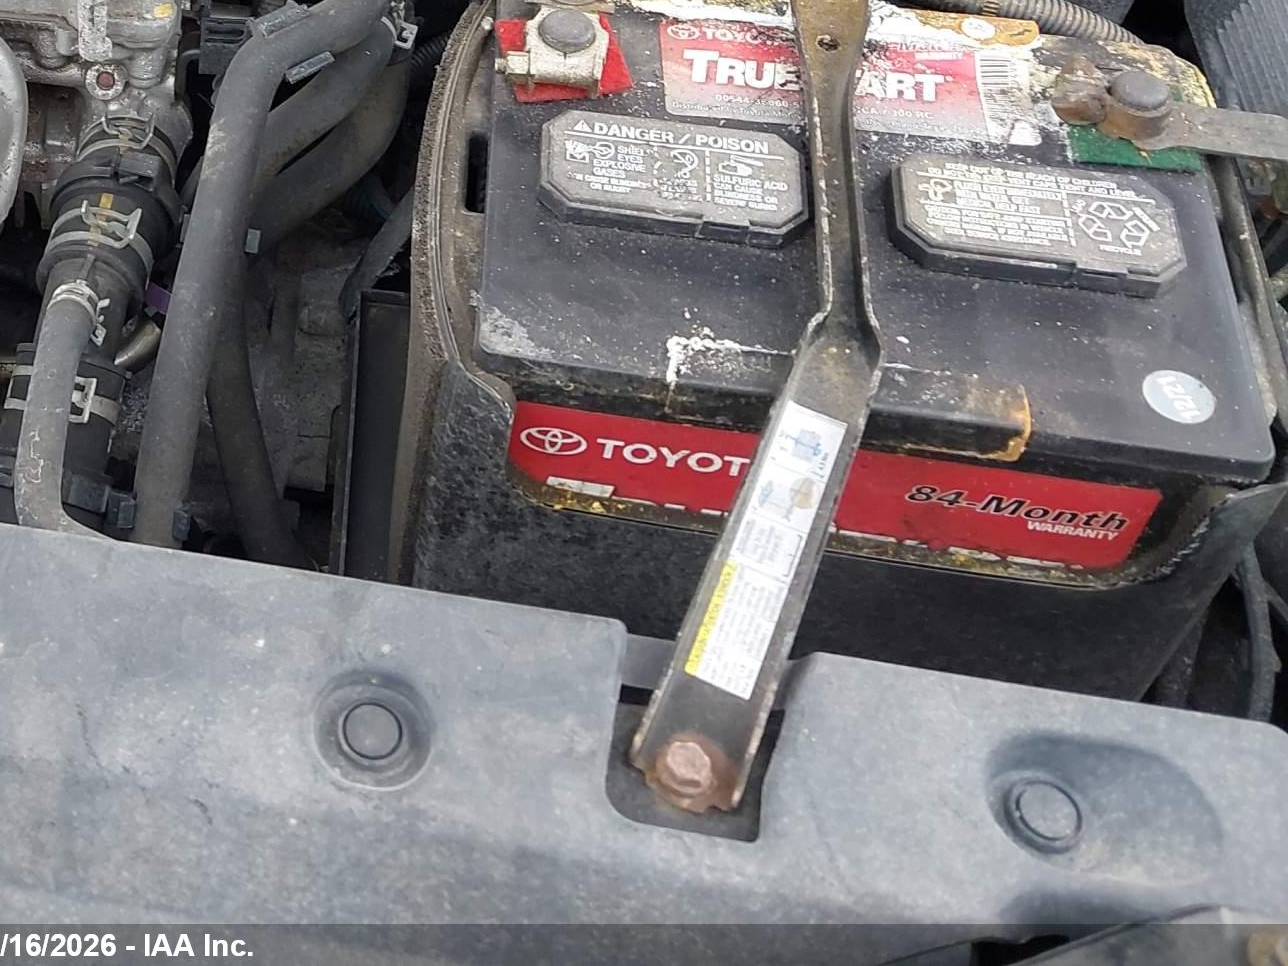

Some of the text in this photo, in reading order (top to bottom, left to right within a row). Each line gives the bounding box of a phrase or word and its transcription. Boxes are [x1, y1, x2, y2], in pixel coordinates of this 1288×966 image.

[594, 121, 675, 144] DANGER
[695, 134, 769, 155] POISON
[592, 158, 646, 172] EXPLOSIVE
[592, 167, 625, 178] GASES
[713, 173, 788, 191] SULFURIC ACID
[596, 438, 751, 477] TOYOT
[905, 485, 1130, 531] 84-Month
[1027, 520, 1120, 541] WARRANTY
